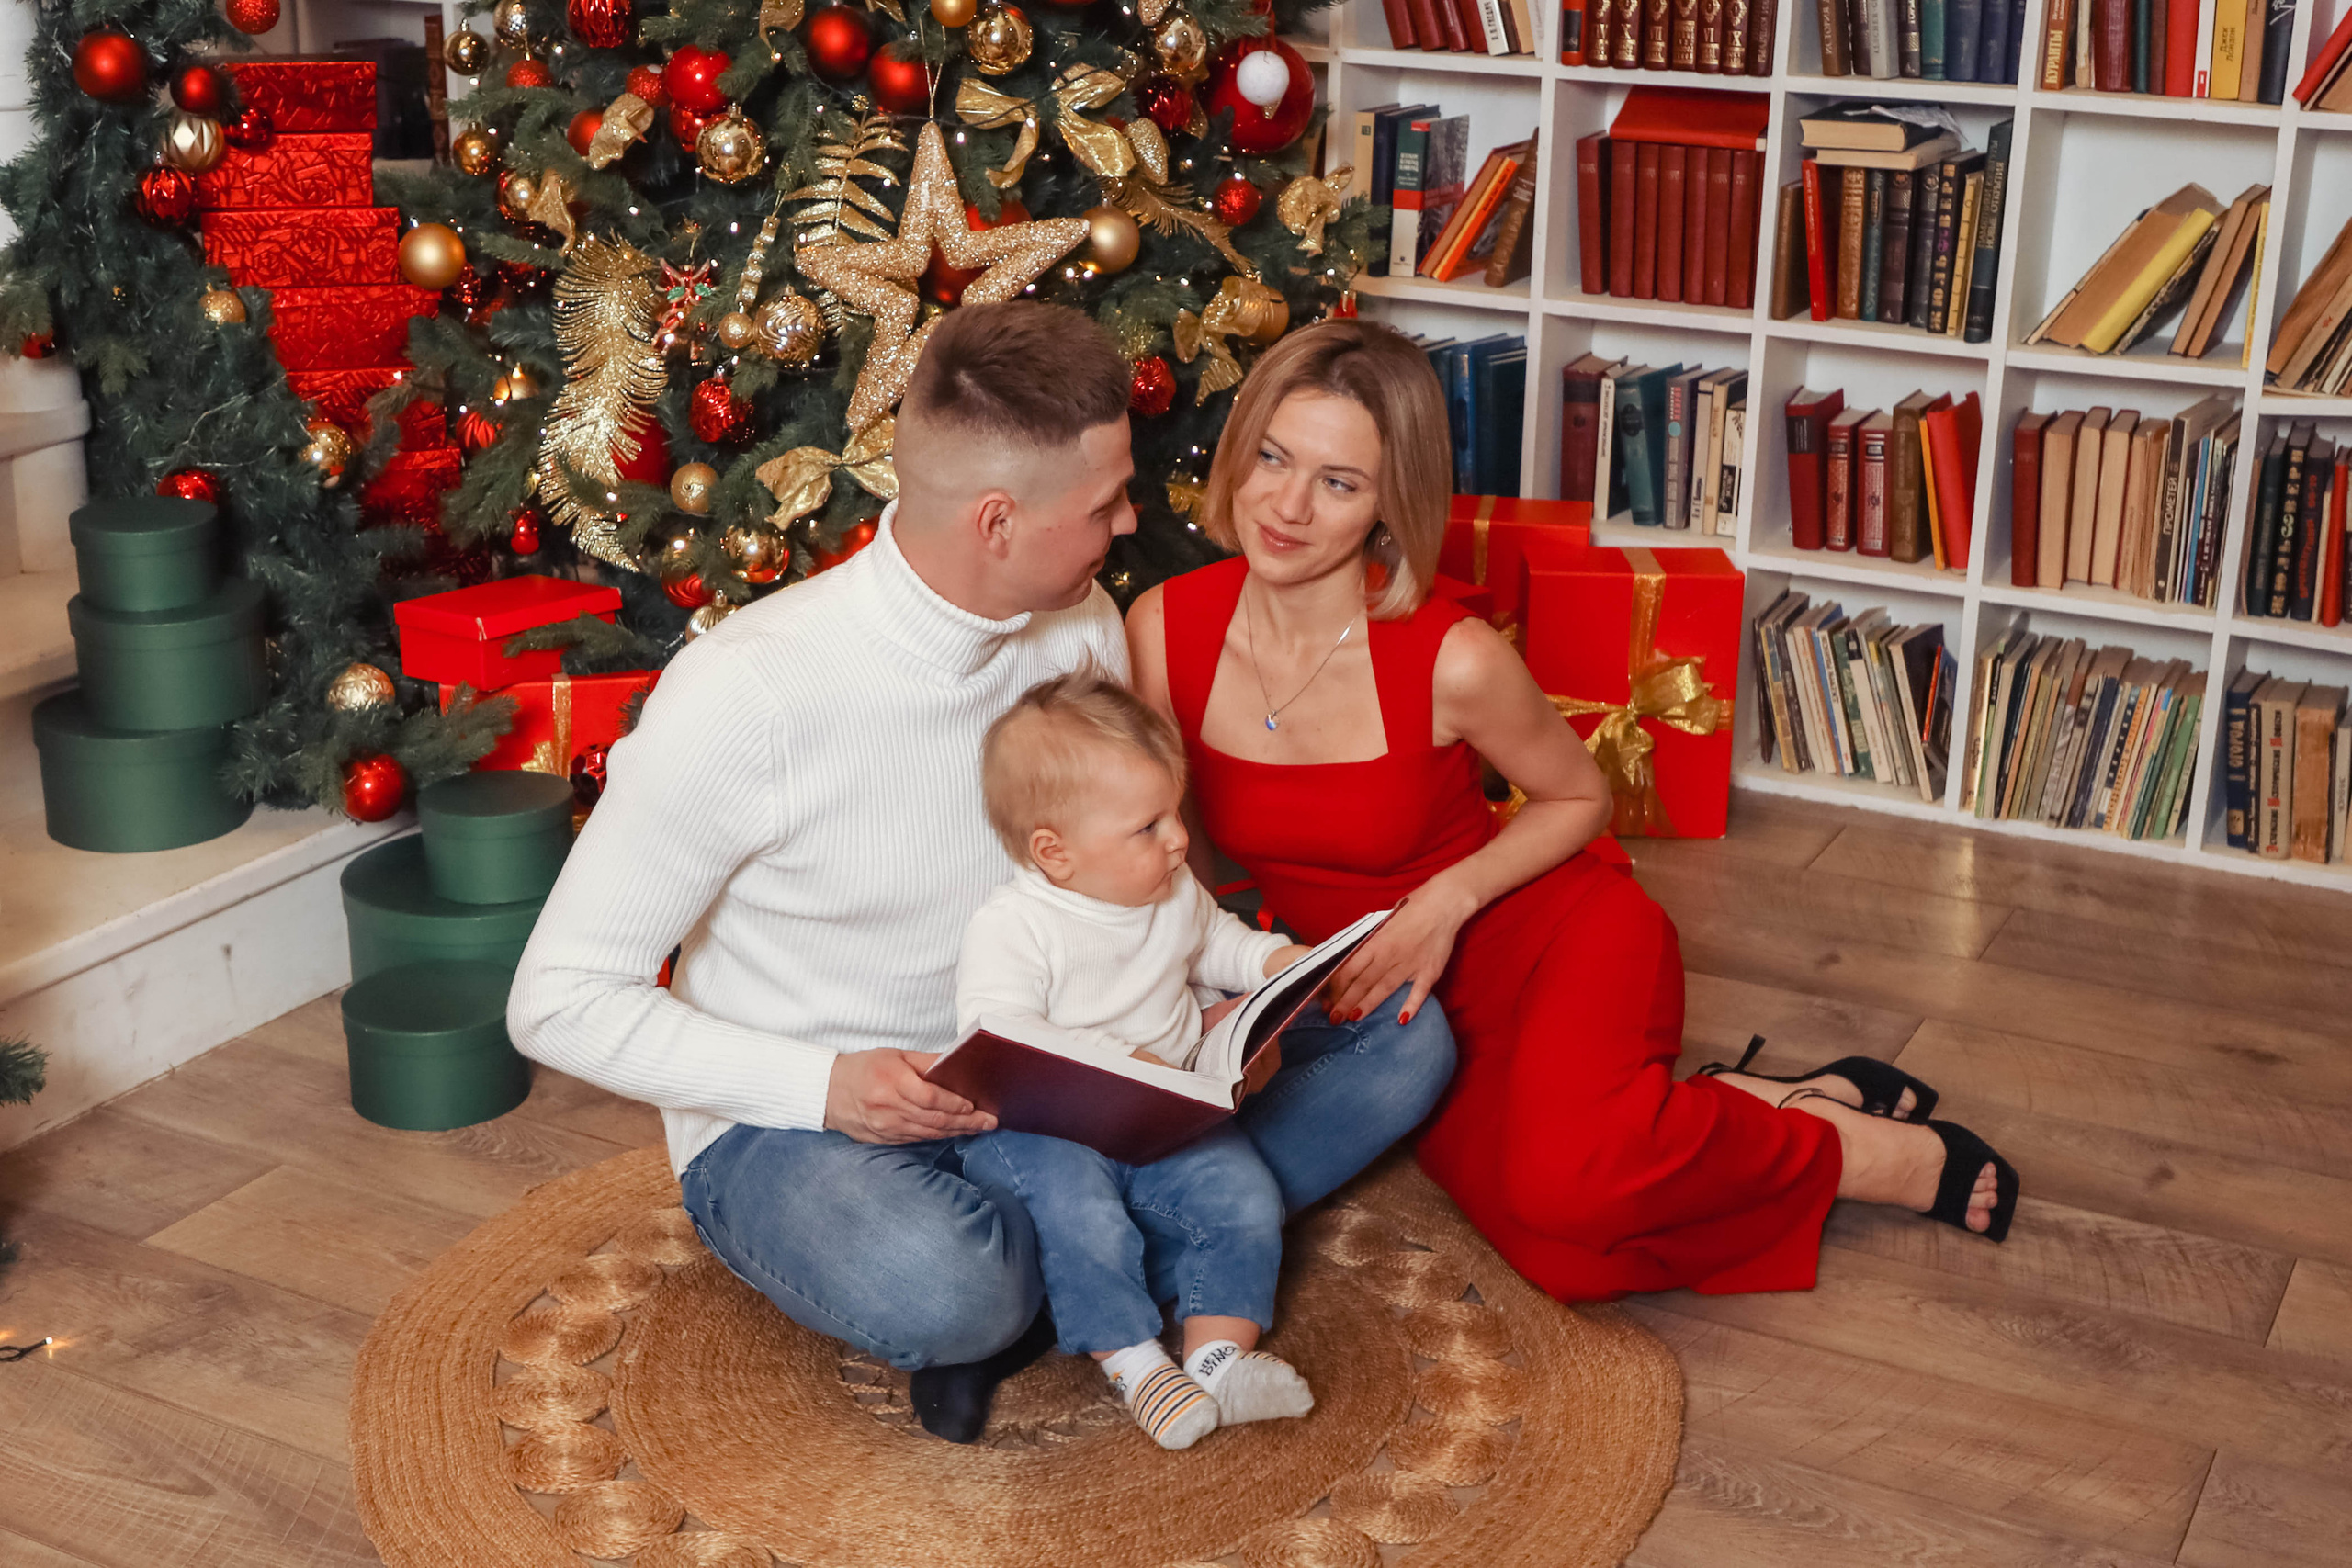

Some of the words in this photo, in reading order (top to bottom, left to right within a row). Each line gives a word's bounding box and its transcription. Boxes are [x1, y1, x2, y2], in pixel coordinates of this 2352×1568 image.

[1823, 7, 1833, 55] ИСТОРИЯ
[2044, 29, 2063, 84] КУРАНТЫ
[2220, 27, 2228, 52] Джек
[2226, 27, 2236, 62] Лондон
[1990, 161, 2004, 213] ОТКРЫТИЯ
[1930, 255, 1947, 330] ЖЮЛЬ
[1939, 164, 1956, 228] ВЕРН
[1986, 217, 1997, 249] НОВЫЕ
[2162, 476, 2178, 535] ПРОМЕТЕЙ
[2269, 538, 2291, 615] ЖЮЛЬ
[2283, 448, 2304, 513] ВЕРН
